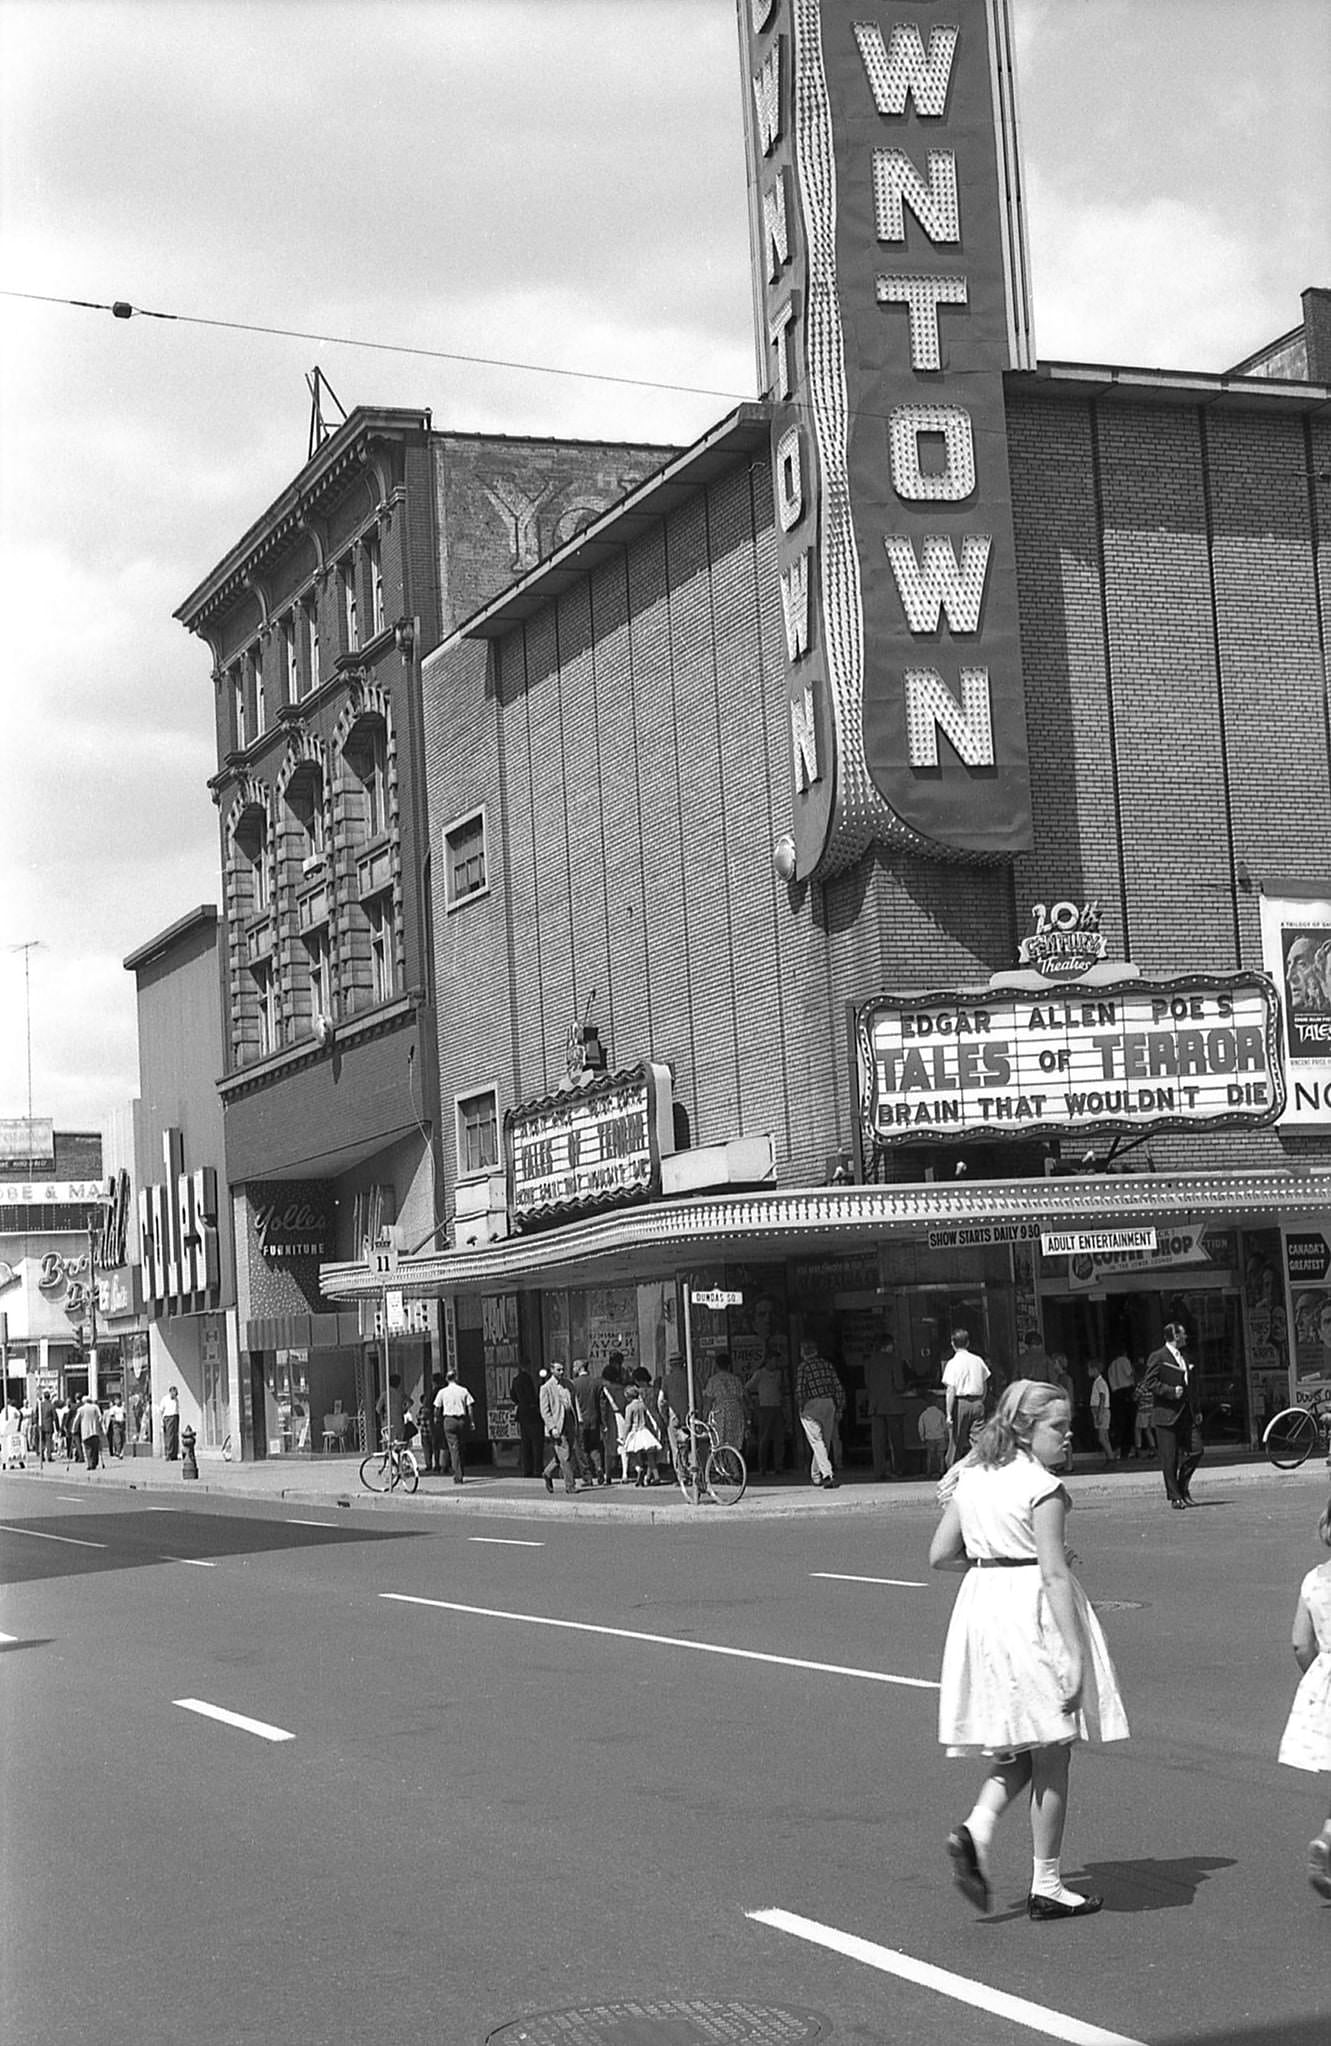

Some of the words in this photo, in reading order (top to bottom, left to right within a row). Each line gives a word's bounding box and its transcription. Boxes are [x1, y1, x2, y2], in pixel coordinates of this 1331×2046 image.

[1032, 901, 1098, 934] 20th
[1029, 933, 1100, 957] CENTURY
[1037, 955, 1091, 974] Theatres
[902, 1010, 991, 1038] EDGAR
[1028, 1002, 1116, 1031] ALLEN
[876, 1042, 1011, 1092] TALES
[1039, 1049, 1071, 1073] OF
[1093, 1026, 1265, 1080] TERROR
[878, 1099, 959, 1127] BRAIN
[977, 1094, 1047, 1120] THAT
[1227, 1082, 1268, 1106] DIE
[0, 1186, 32, 1200] BE
[255, 1204, 325, 1249] Yolles
[930, 1231, 957, 1247] SHOW
[960, 1228, 991, 1244] STARTS
[993, 1226, 1019, 1241] DAILY
[1048, 1237, 1075, 1251] ADULT
[1080, 1232, 1152, 1248] ENTERTAINMENT
[263, 1243, 325, 1256] FURNITURE
[1289, 1243, 1324, 1255] CANADA'S
[377, 1255, 390, 1272] 11
[1289, 1259, 1324, 1270] GREATEST
[696, 1293, 724, 1303] DUNDAS
